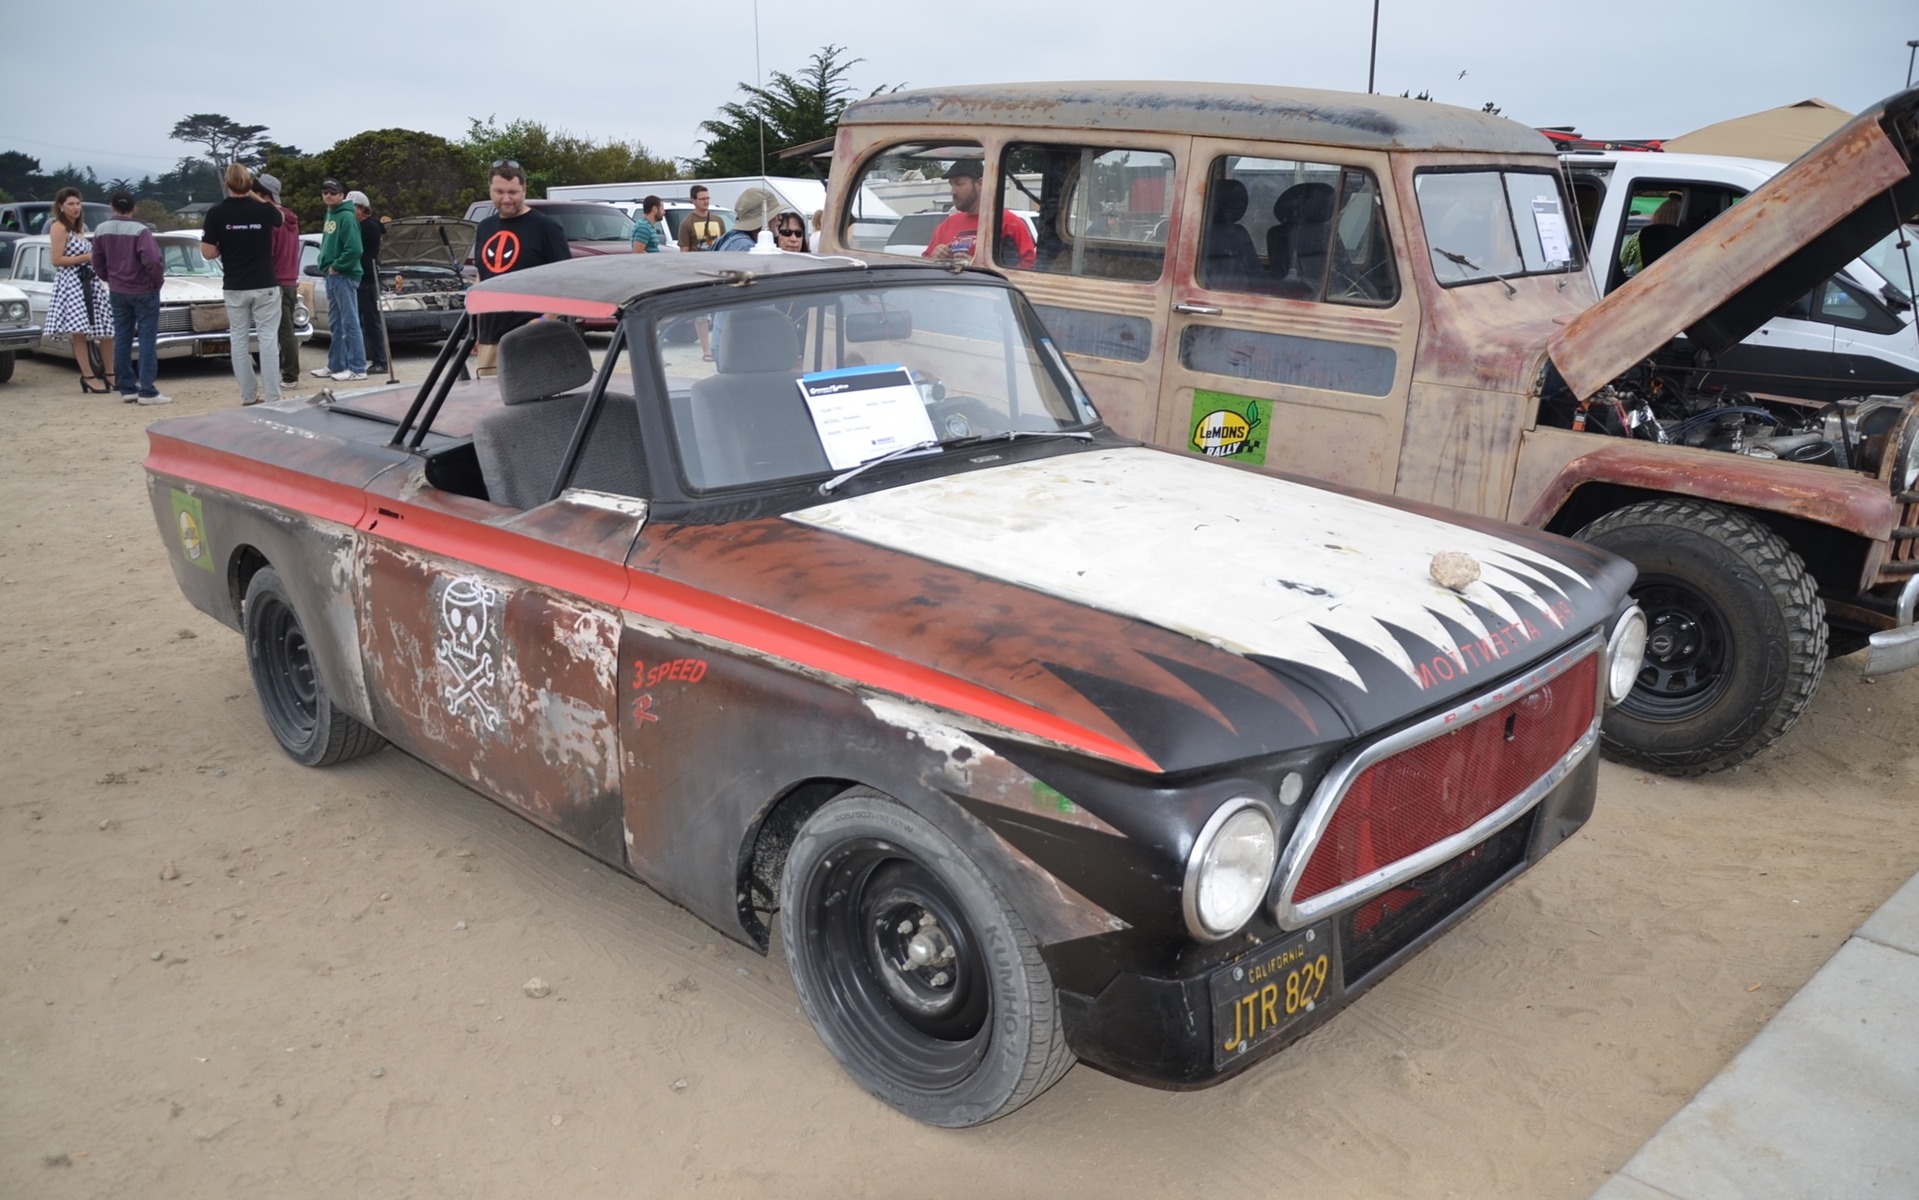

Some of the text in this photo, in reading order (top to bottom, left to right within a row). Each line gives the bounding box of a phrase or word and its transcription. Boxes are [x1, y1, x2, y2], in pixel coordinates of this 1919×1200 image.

[1199, 426, 1246, 439] LeMONS
[1205, 441, 1241, 458] RALLY
[632, 658, 708, 689] 3 SPEED
[985, 924, 1018, 1036] KUMHO
[1248, 944, 1305, 984] CALIFORNIA
[1223, 954, 1328, 1052] JTR 829
